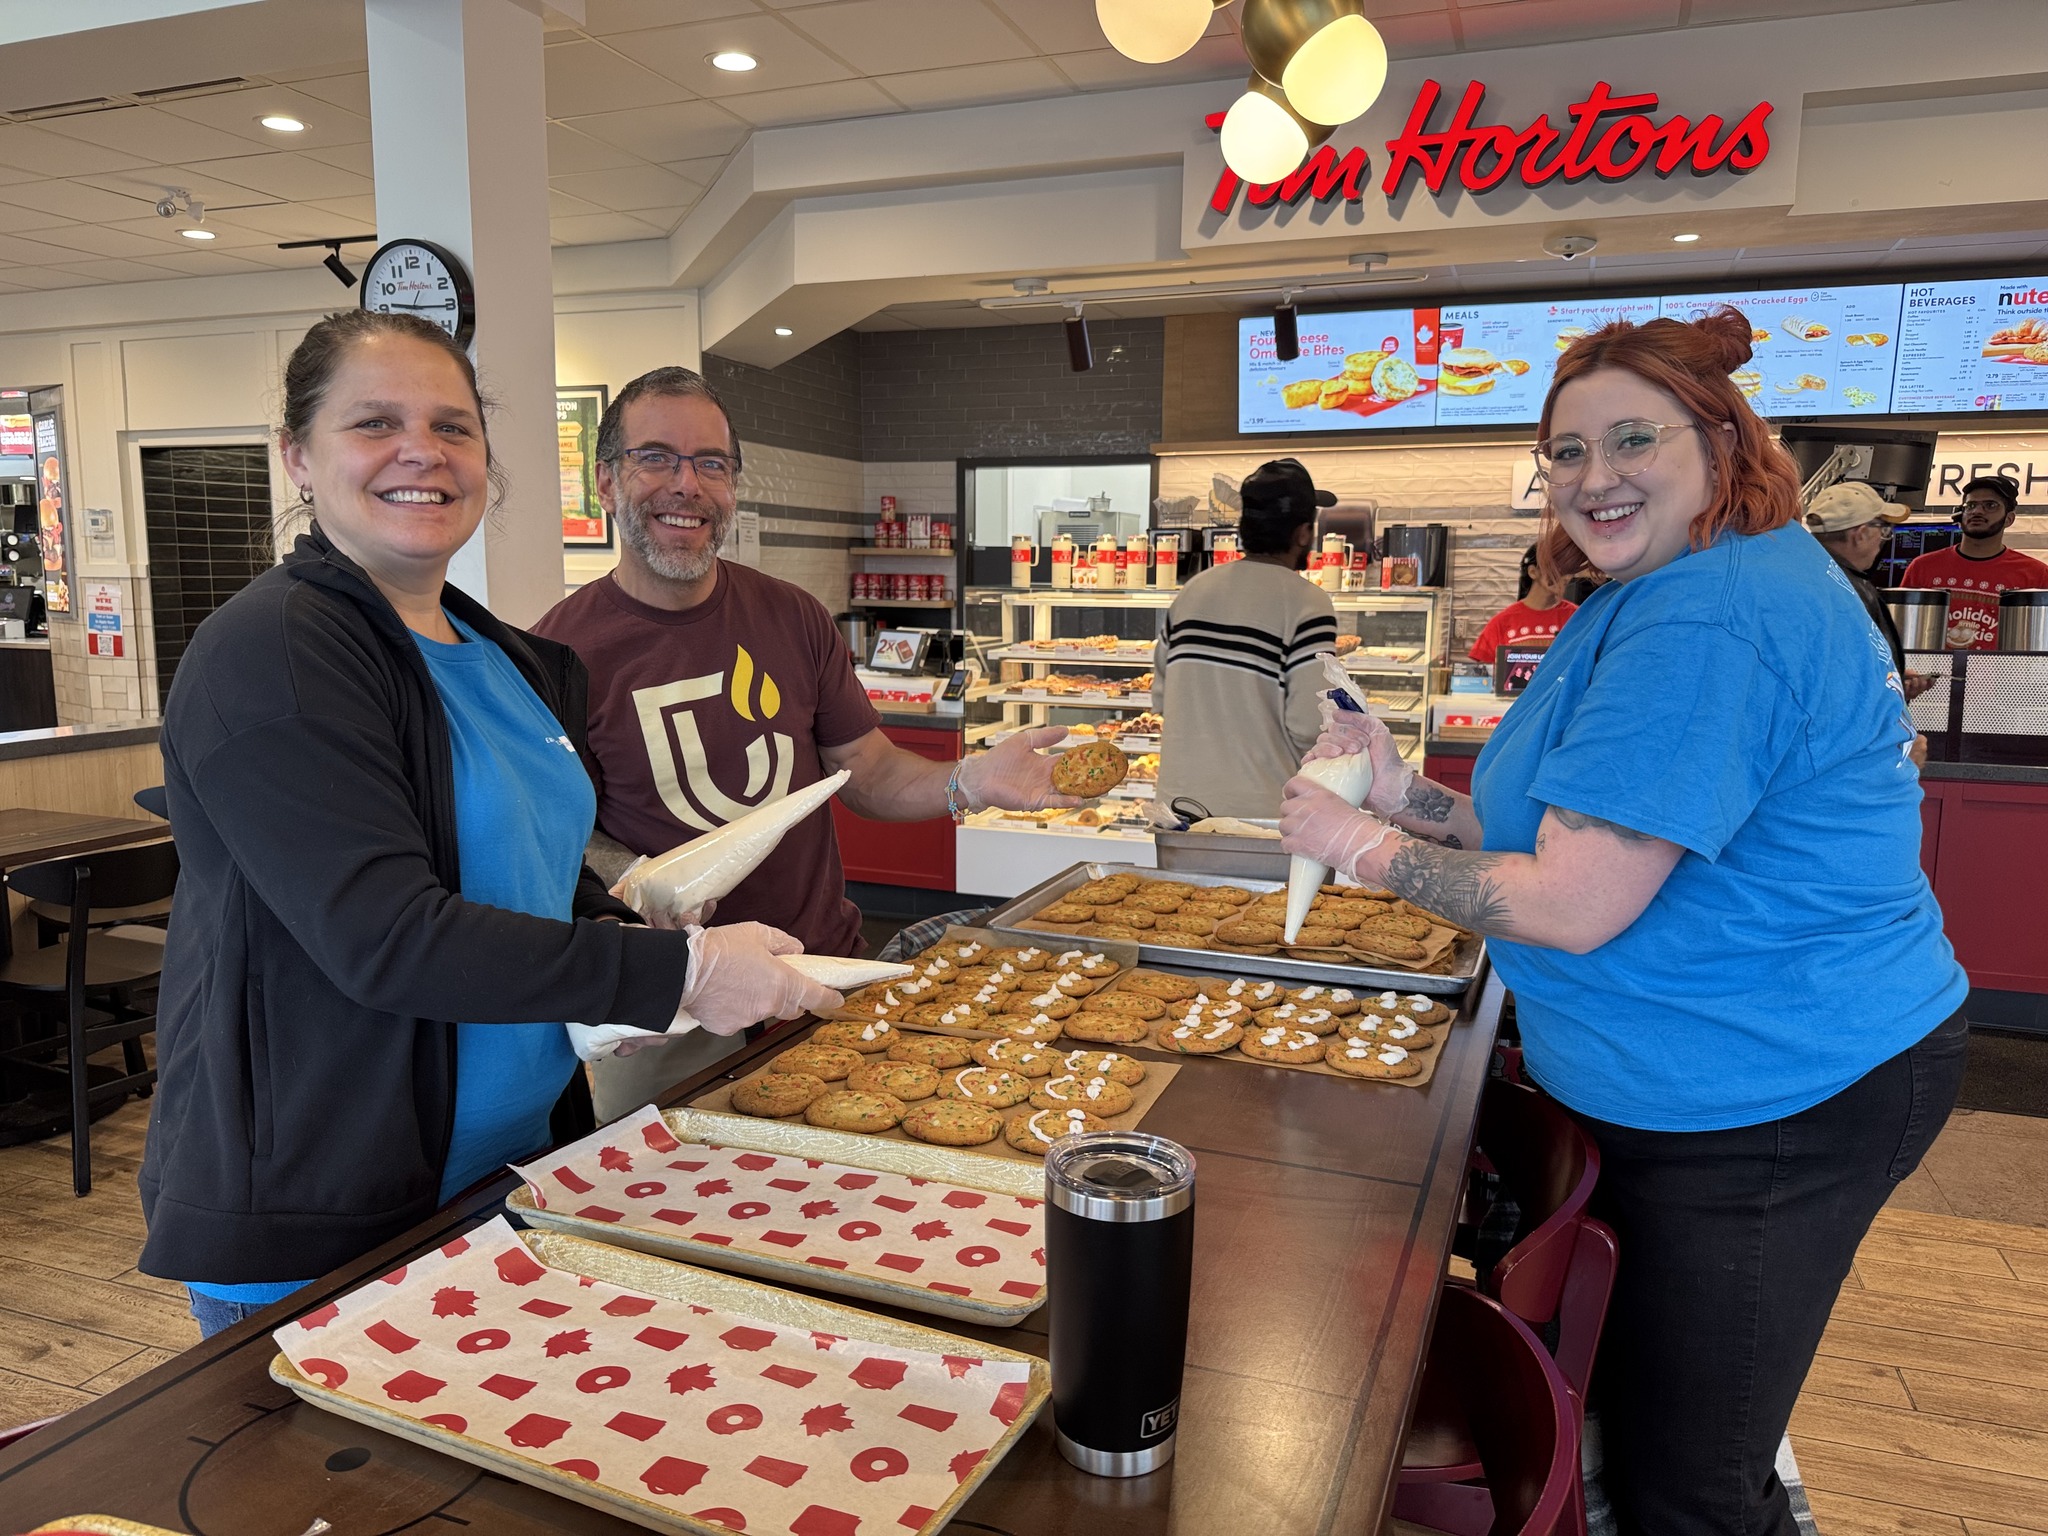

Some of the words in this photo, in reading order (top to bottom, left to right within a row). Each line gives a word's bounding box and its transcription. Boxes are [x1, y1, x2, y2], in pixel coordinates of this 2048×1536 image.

[1381, 79, 1774, 196] Hortons
[405, 256, 420, 269] 12
[426, 263, 431, 275] 1
[391, 265, 403, 278] 11
[381, 282, 396, 295] 10
[397, 281, 409, 291] Tim
[409, 280, 433, 291] Hortons
[437, 277, 449, 290] 2
[1910, 287, 1935, 297] HOT
[445, 298, 456, 311] 3
[1665, 302, 1684, 310] 100%
[1727, 298, 1749, 306] Fresh
[1751, 296, 1785, 305] Cracked
[1787, 296, 1808, 304] Eggs
[1909, 296, 1976, 308] BEVERAGES
[1445, 311, 1479, 320] MEALS
[1581, 308, 1599, 316] your
[1600, 306, 1614, 314] day
[1616, 304, 1635, 313] right
[441, 320, 453, 332] 4
[1313, 344, 1345, 356] Bites
[556, 401, 577, 411] RTON
[1928, 462, 2048, 497] RSH
[876, 639, 896, 654] 2x
[1147, 1401, 1178, 1431] YET
